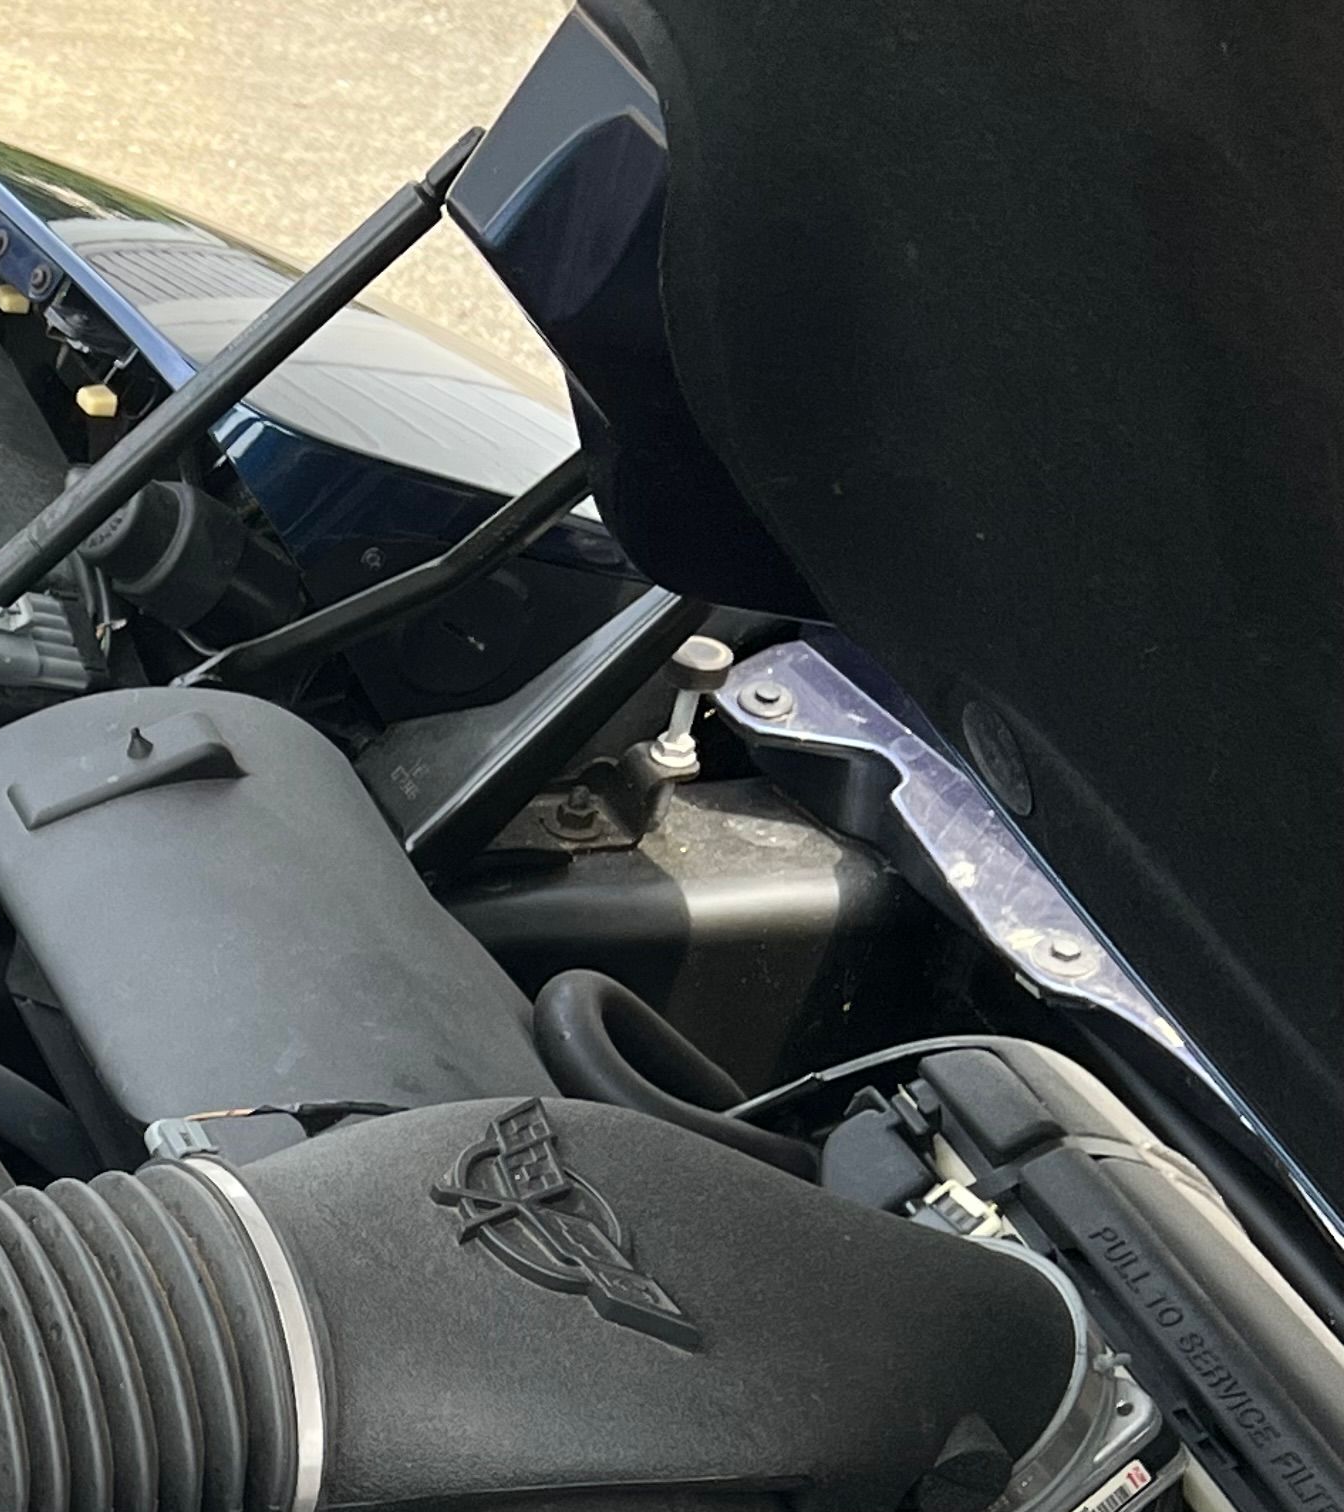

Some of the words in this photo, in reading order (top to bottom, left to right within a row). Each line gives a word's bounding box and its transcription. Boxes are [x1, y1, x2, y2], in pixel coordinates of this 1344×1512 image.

[1089, 1227, 1151, 1294] PULL
[1146, 1296, 1185, 1328] TO
[1176, 1333, 1282, 1448] SERVICE
